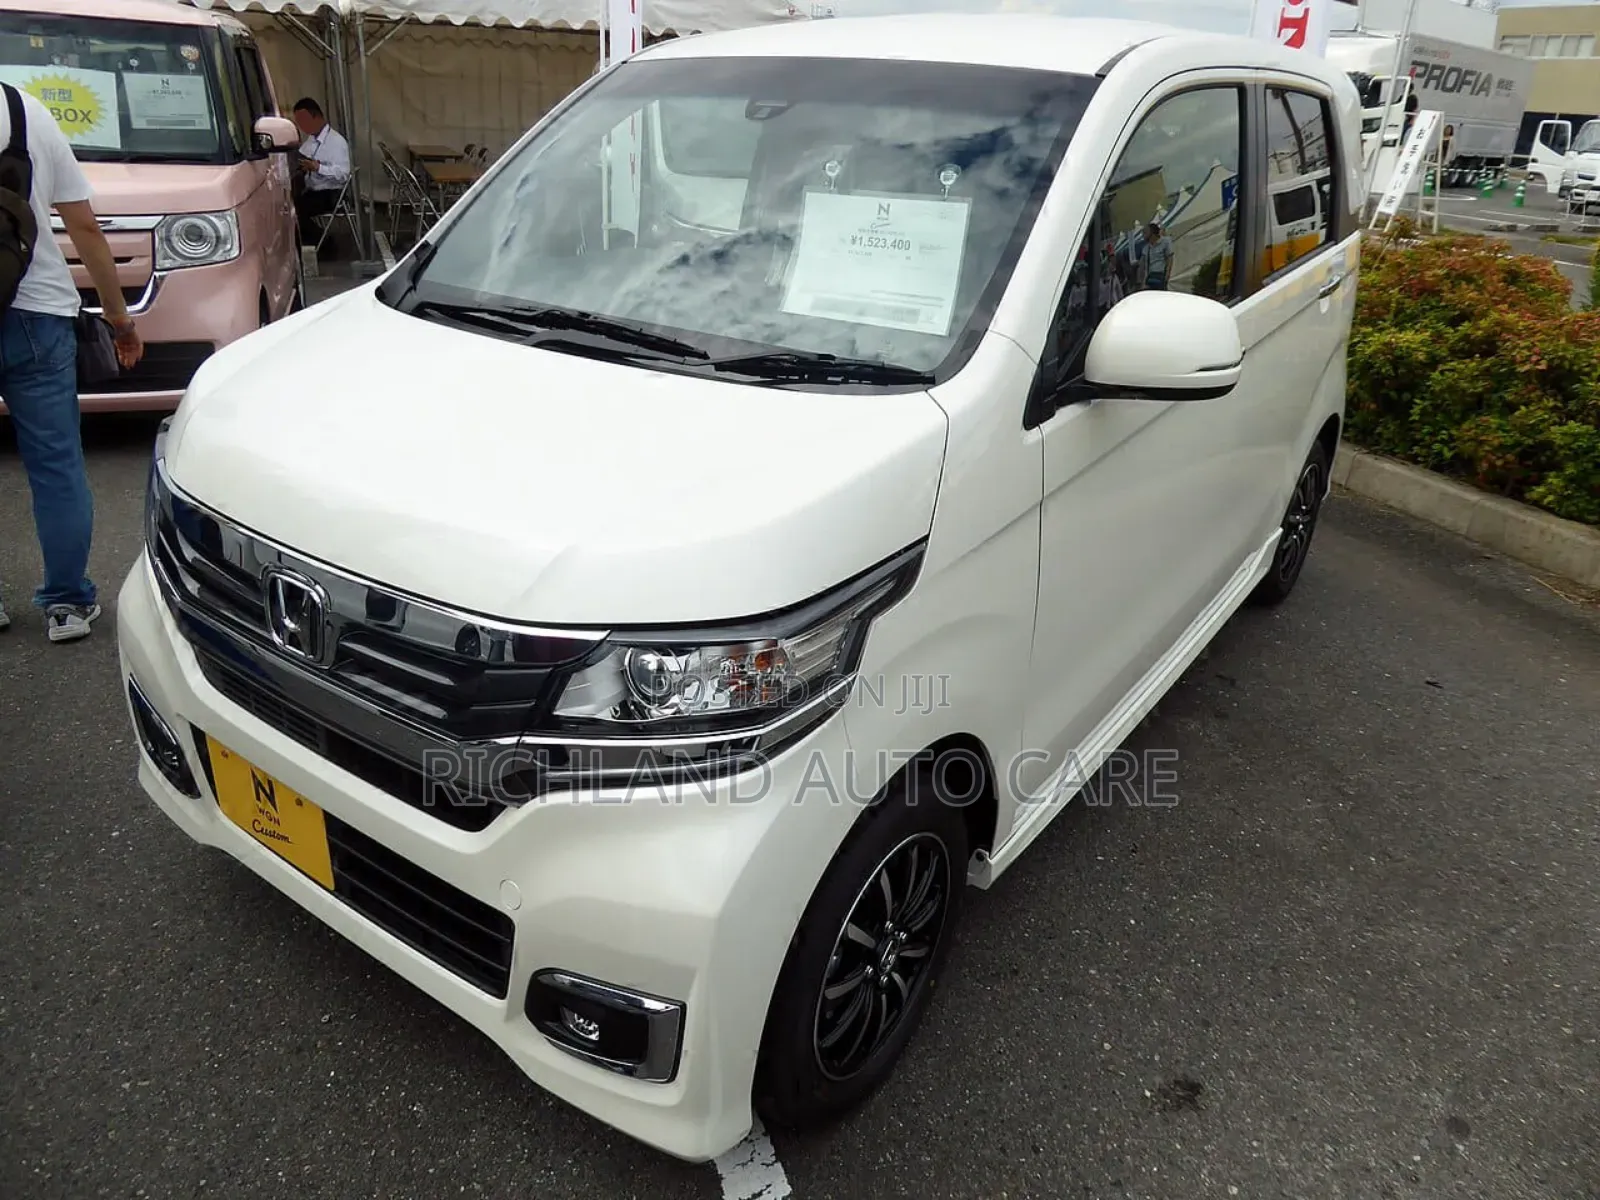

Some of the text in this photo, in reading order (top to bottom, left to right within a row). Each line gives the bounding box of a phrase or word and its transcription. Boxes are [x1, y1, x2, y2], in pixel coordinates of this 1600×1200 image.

[1408, 60, 1494, 97] PROFIA
[40, 88, 72, 102] 新型
[877, 202, 891, 216] N
[250, 768, 280, 814] N
[251, 818, 298, 844] Custom
